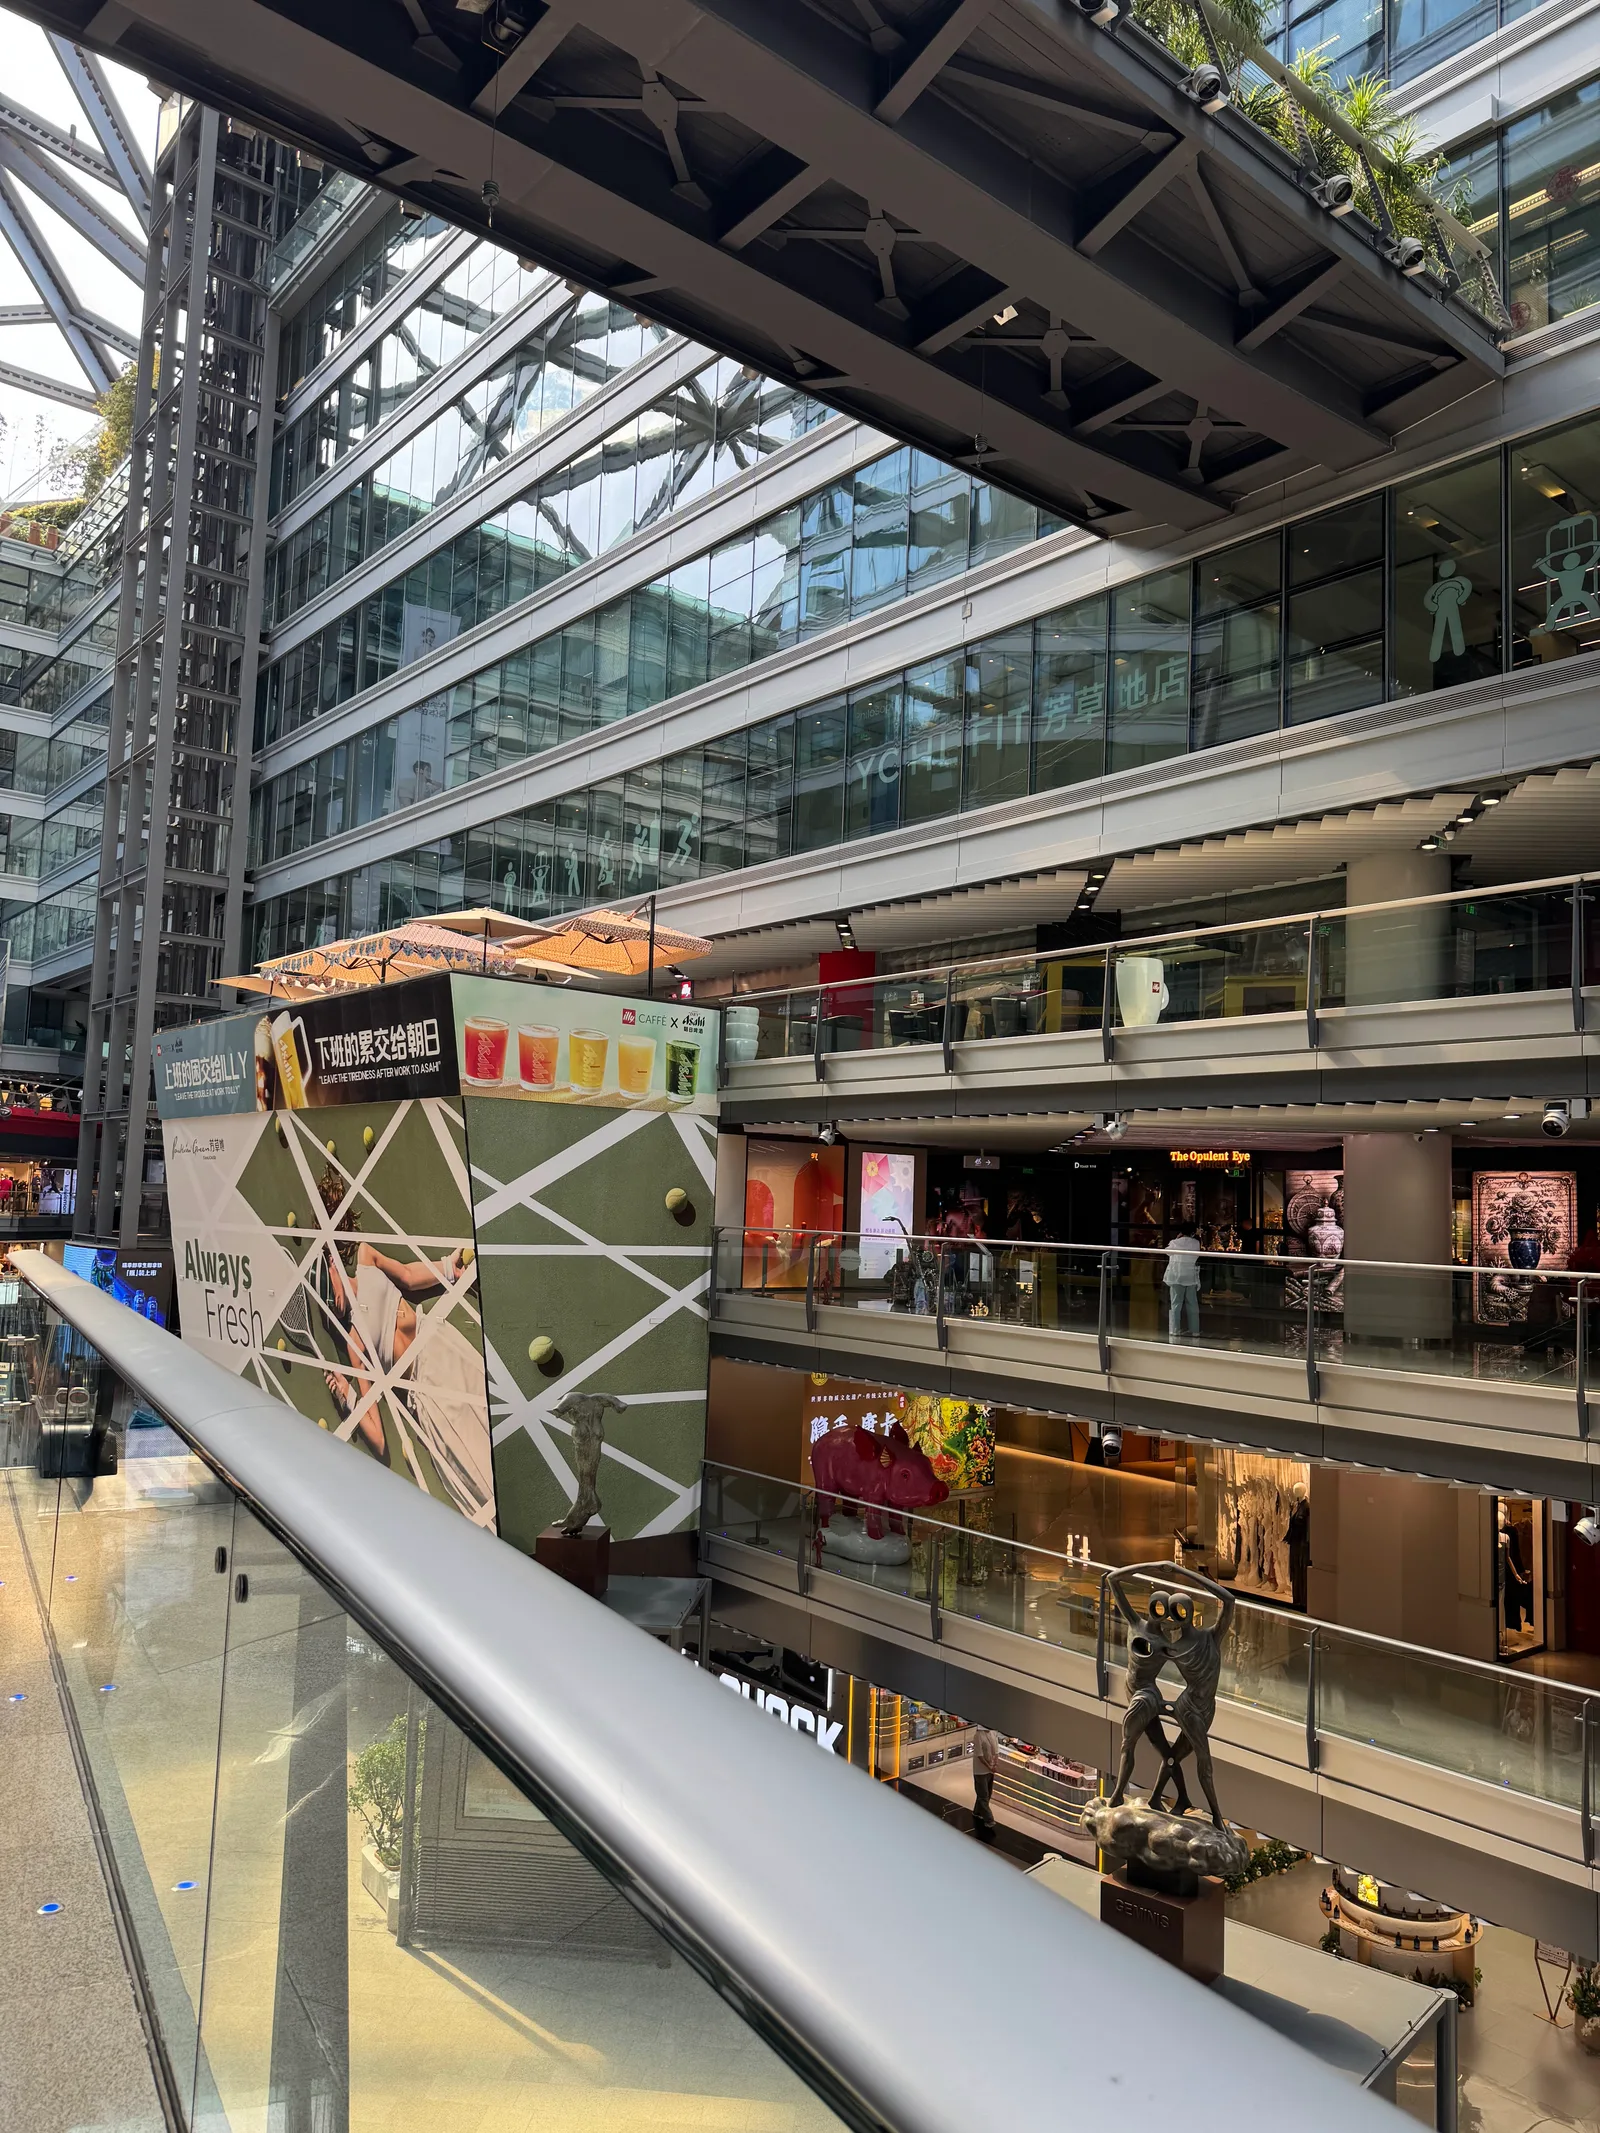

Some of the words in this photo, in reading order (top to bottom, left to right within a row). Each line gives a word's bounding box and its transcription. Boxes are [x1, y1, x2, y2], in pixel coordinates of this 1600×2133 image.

[970, 703, 1030, 757] FIT
[622, 1010, 635, 1024] illy
[682, 1015, 706, 1027] Asahi
[315, 1018, 441, 1069] 下班的累交给朝日
[338, 1072, 348, 1083] THE
[348, 1069, 376, 1082] TIREDNESS
[376, 1067, 394, 1079] AFTER
[394, 1065, 411, 1077] WORK
[411, 1064, 420, 1075] TO
[1074, 1161, 1080, 1169] D
[1170, 1151, 1189, 1161] The
[1189, 1150, 1229, 1164] Opulent
[1232, 1150, 1251, 1164] Eye
[185, 1238, 252, 1298] Always
[205, 1288, 265, 1351] Fresh
